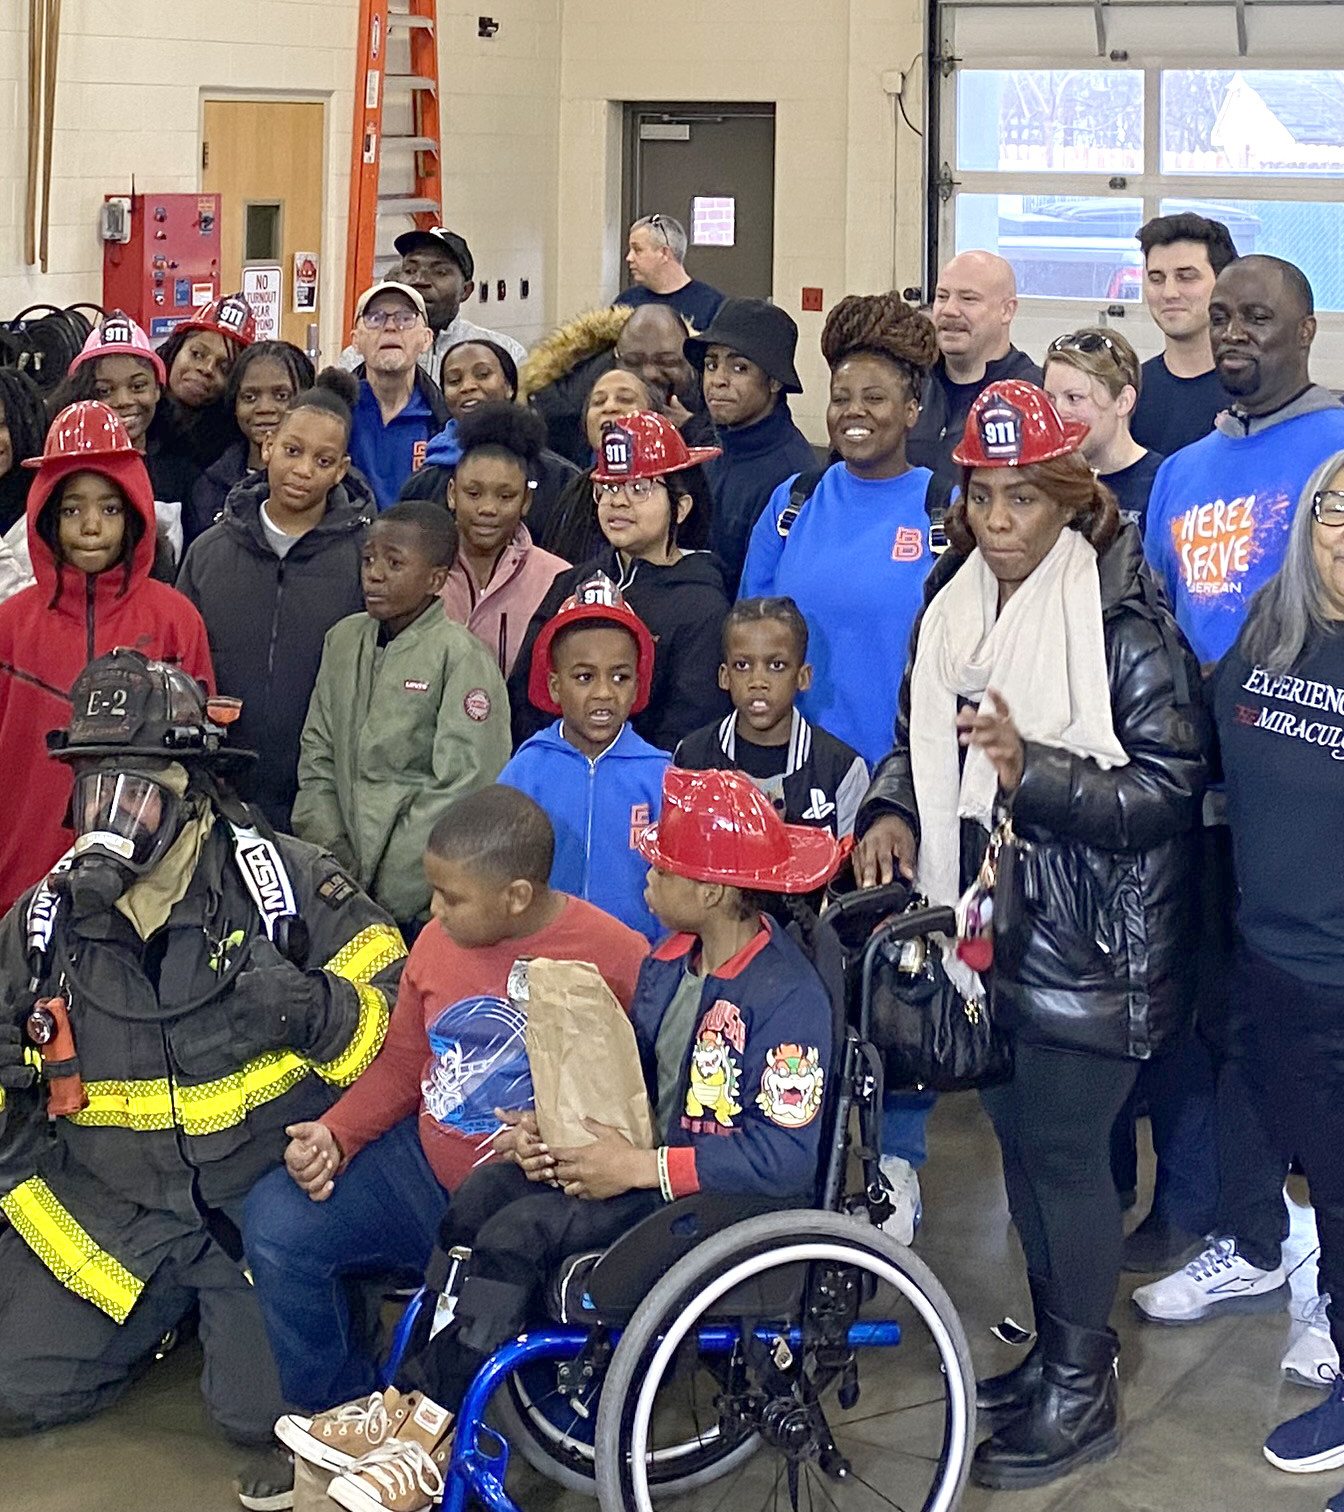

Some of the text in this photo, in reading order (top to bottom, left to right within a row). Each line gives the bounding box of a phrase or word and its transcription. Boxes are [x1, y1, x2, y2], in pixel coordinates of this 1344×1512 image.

[256, 274, 269, 290] NO
[247, 291, 277, 304] TURNOUT
[220, 307, 244, 326] 911
[105, 327, 128, 342] 911
[984, 421, 1016, 444] 911
[605, 443, 627, 463] 911
[1181, 535, 1250, 588] SERVE
[584, 589, 612, 606] 911
[86, 689, 128, 716] E-2
[244, 844, 286, 911] MSA
